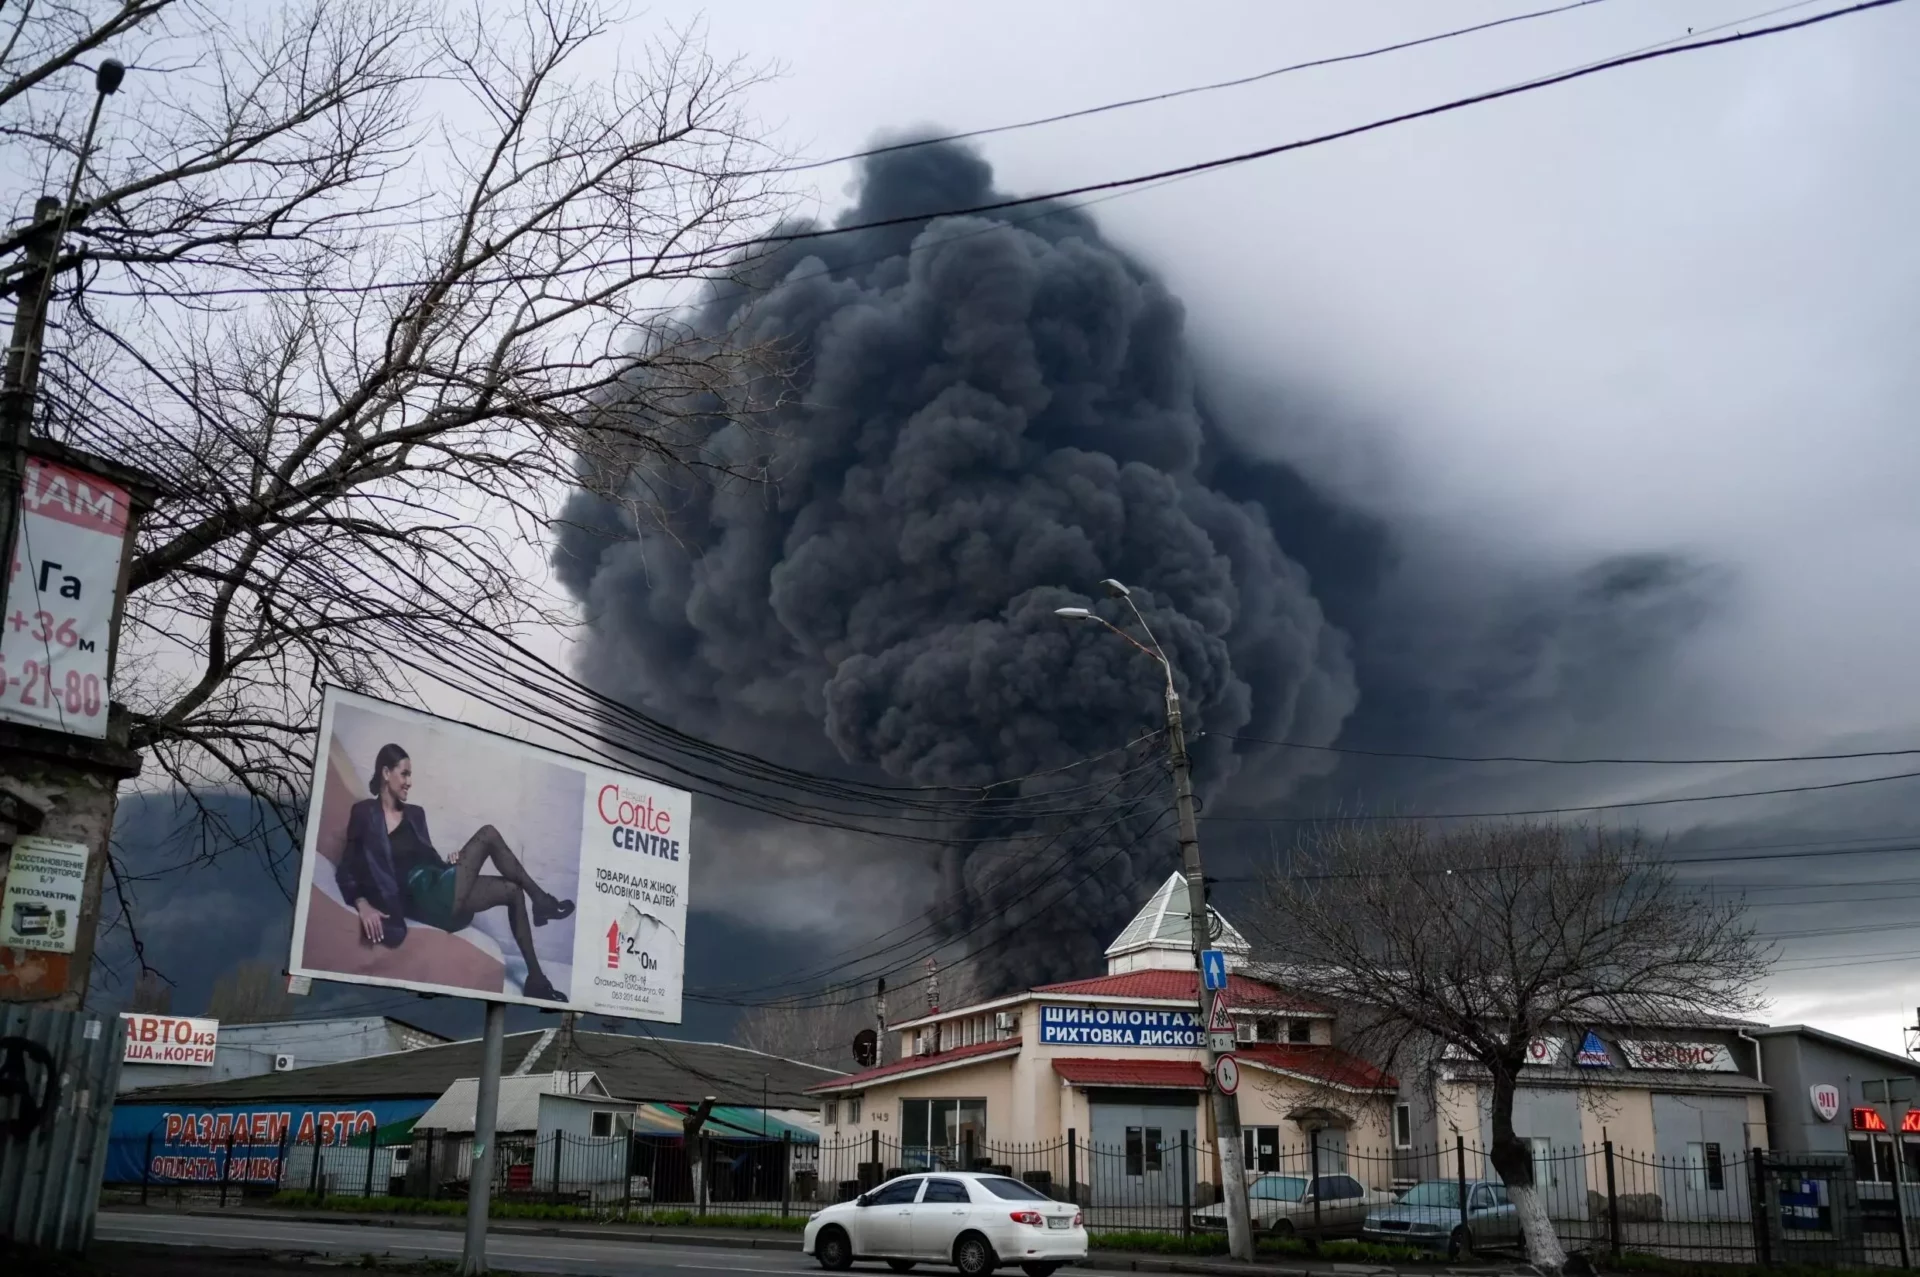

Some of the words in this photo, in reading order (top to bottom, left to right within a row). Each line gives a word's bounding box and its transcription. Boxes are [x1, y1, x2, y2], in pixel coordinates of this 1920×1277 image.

[39, 560, 81, 600] Га
[598, 784, 671, 835] Conte
[612, 825, 679, 862] CENTRE
[14, 863, 81, 879] АККУМУЛЯТОРОВ
[15, 853, 84, 870] ВОССТАНОВЛЕНИЕ
[595, 881, 640, 900] ЧОЛОВІКІВ
[641, 891, 651, 903] ТА
[596, 867, 629, 885] ТОВАРИ
[630, 876, 648, 889] ДЛЯ
[649, 880, 679, 898] ЖІНОК,
[9, 886, 76, 902] АВТОЭЛЕКТРИК
[1046, 1007, 1205, 1027] ШИНОМОНТАЖ
[126, 1017, 192, 1046] АВТО
[1045, 1026, 1135, 1044] РИХТОВКА
[1139, 1030, 1207, 1046] ДИСКОВ
[123, 1044, 153, 1060] ША
[164, 1046, 214, 1062] КОРЕИ
[1641, 1046, 1714, 1064] СЕРВИС
[1818, 1091, 1836, 1108] 911
[871, 1112, 889, 1122] 149
[164, 1111, 291, 1153] РАЗДАЕМ
[295, 1110, 377, 1148] АВТО
[151, 1155, 218, 1181] ОПЛАТА
